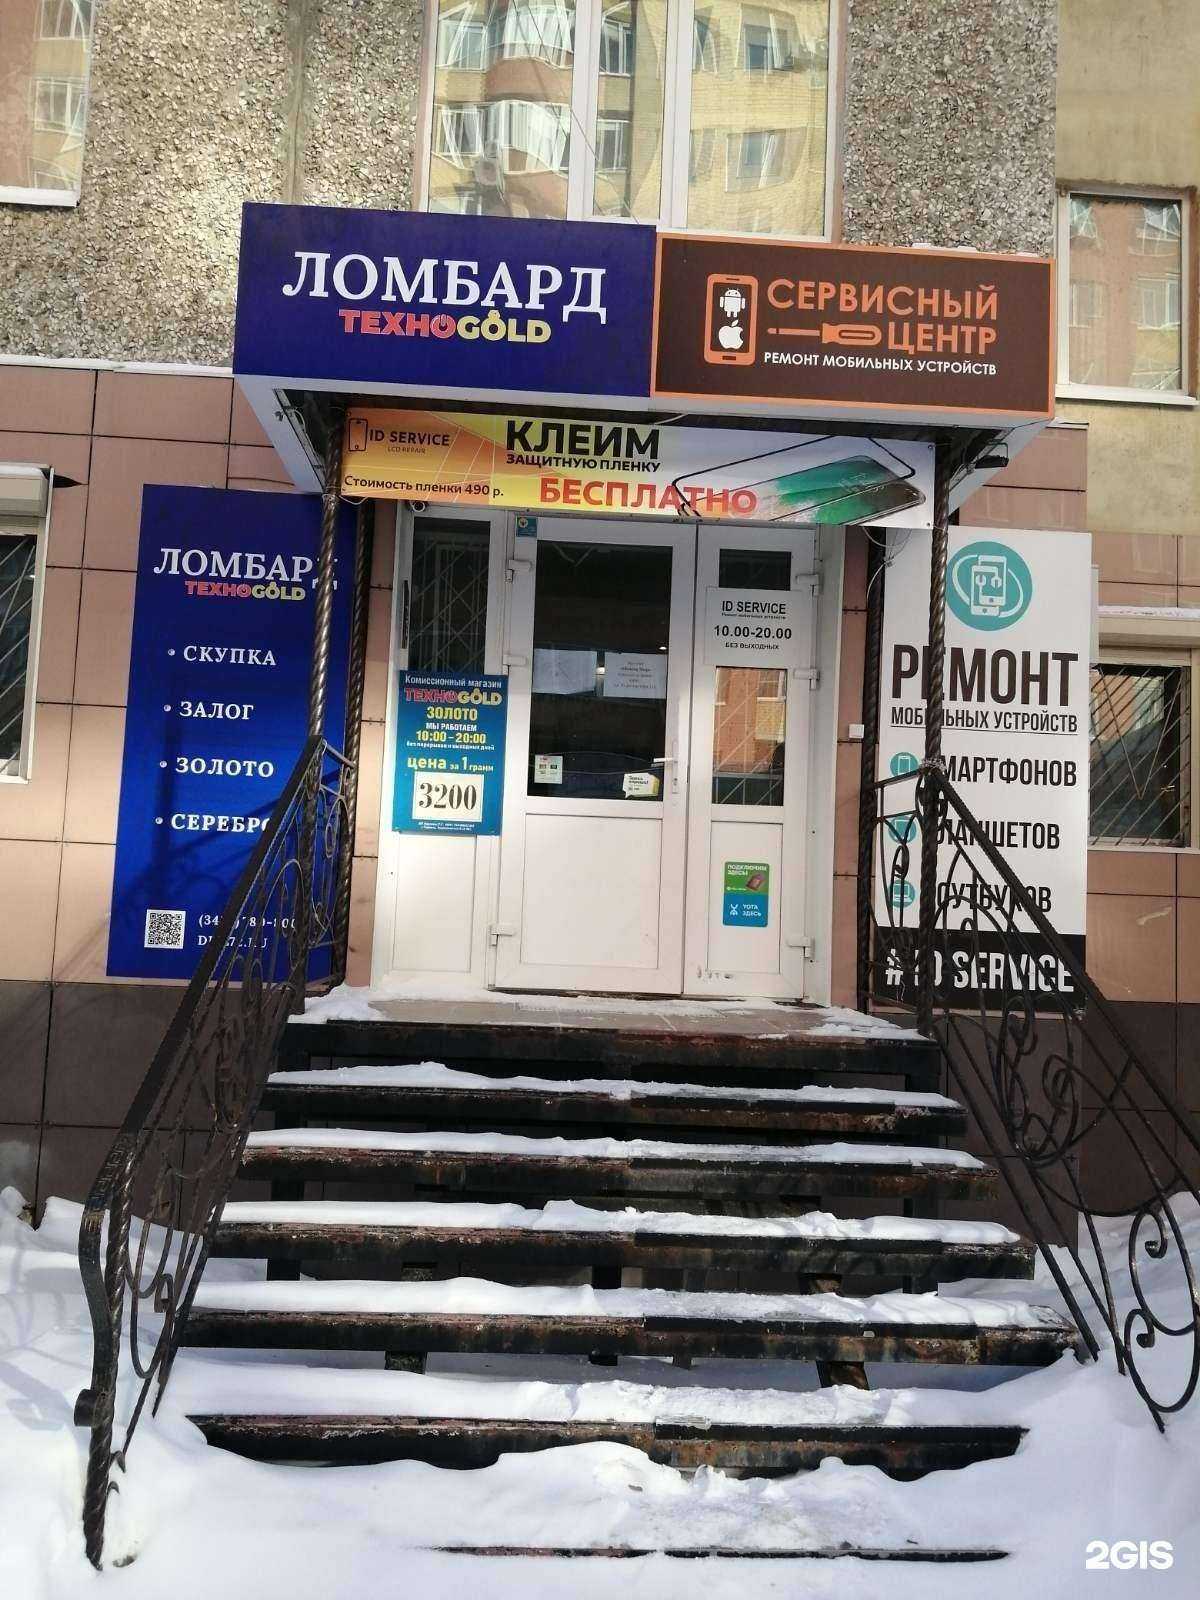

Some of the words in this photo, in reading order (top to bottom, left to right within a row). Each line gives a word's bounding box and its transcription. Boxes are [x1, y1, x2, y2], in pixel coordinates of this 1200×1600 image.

[282, 251, 607, 324] ЛОМБАРД
[767, 278, 997, 320] СЕРВИСНЫЙ
[888, 321, 997, 355] ЦЕНТР
[764, 351, 820, 366] РЕМОНТ
[823, 354, 913, 371] МОБИЛЬНЫХ
[916, 357, 996, 375] УСТРОЙСТВ
[370, 429, 384, 441] ID
[389, 431, 450, 446] SERVICE
[506, 419, 660, 459] КЛЕИМ
[506, 453, 597, 470] ЗАЩИТНУЮ
[600, 459, 661, 473] ПЛЕНКУ
[344, 475, 412, 490] Стоимость
[415, 481, 462, 494] пленки
[465, 484, 490, 495] 490
[492, 486, 504, 498] р.
[539, 478, 758, 515] БЕСПЛАТНО
[154, 548, 338, 590] ЛОМБАР
[722, 600, 733, 612] ID
[737, 601, 787, 615] SERVICE
[714, 625, 792, 640] 10.00-20.00
[183, 646, 276, 665] СКУПКА
[739, 642, 779, 650] ВЫХОДНЫХ
[405, 674, 466, 686] Комиссионный
[468, 680, 502, 688] магазин
[179, 701, 254, 720] ЗАЛОГ
[427, 706, 478, 720] ЗОЛОТО
[891, 707, 989, 729] МОБЬНЫХ
[994, 710, 1078, 732] УСТРОЙСТВ
[426, 722, 440, 730] МЫ
[440, 723, 477, 731] РАБОТАЕМ
[175, 757, 274, 777] ЗОЛОТО
[407, 757, 447, 769] цена
[461, 756, 468, 770] 1
[941, 755, 1077, 786] МАРТФОНОВ
[418, 782, 477, 810] 3200
[952, 951, 1074, 992] SERVICE
